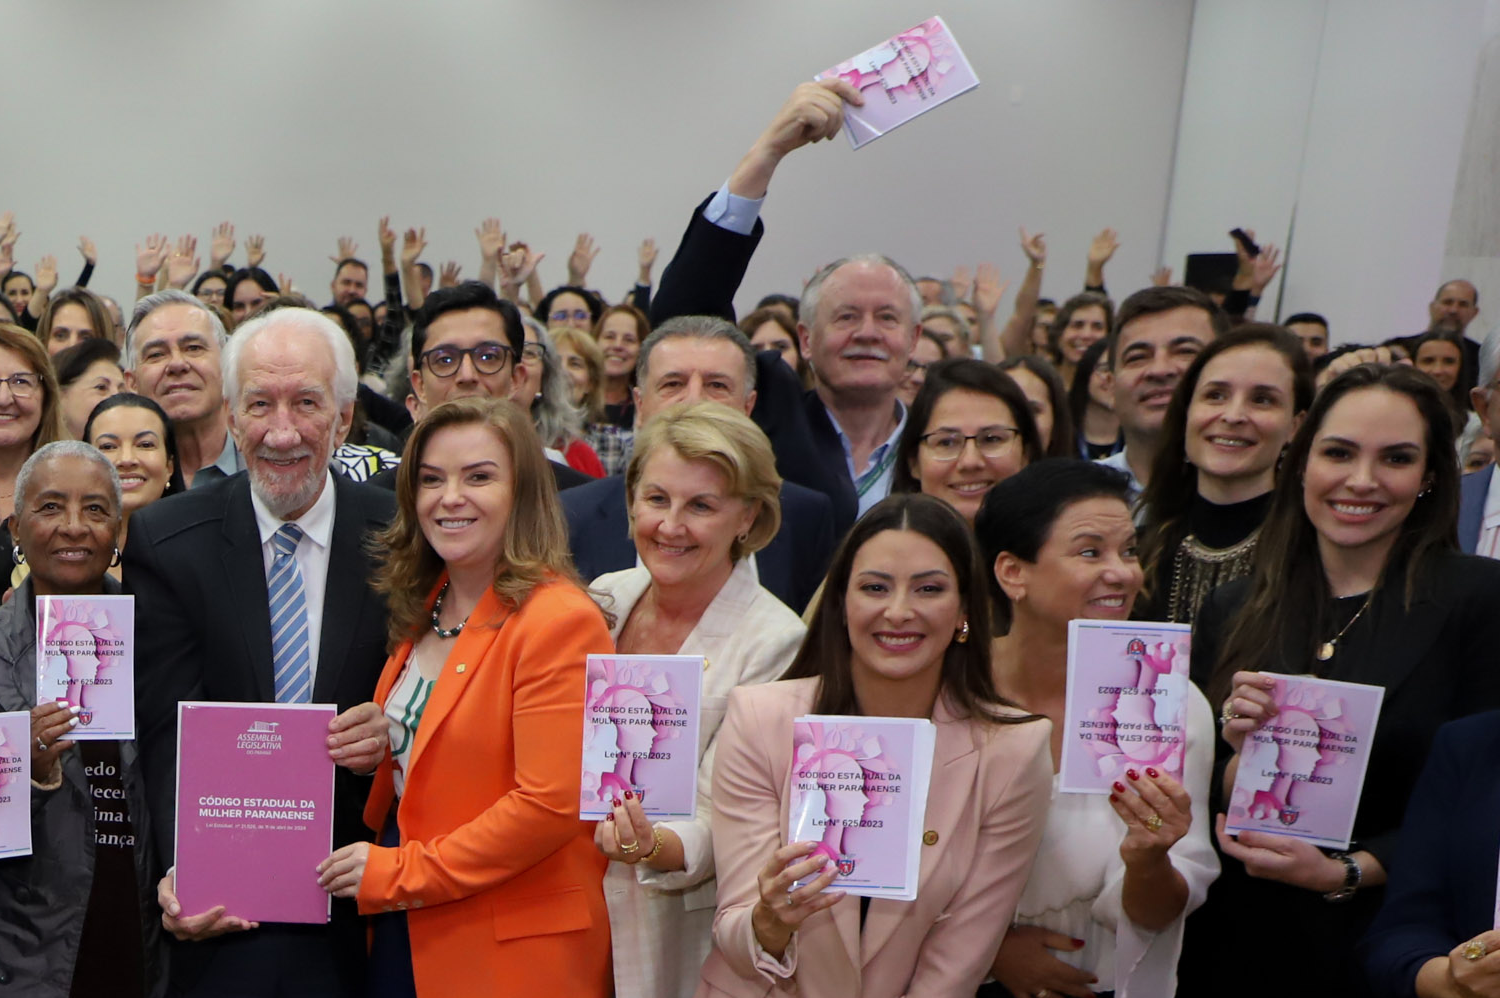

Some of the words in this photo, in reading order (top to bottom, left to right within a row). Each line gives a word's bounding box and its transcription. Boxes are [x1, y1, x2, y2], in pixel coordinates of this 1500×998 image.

[592, 705, 626, 713] CÓDIGO
[628, 707, 673, 715] ESTADUAL
[592, 717, 627, 725] MULHER
[629, 719, 688, 727] PARANAENSE
[1080, 720, 1142, 730] PARANAENSE
[237, 733, 282, 742] ASSEMBLEIA
[1079, 732, 1092, 740] DA
[1095, 733, 1141, 742] ESTADUAL
[1293, 729, 1341, 742] ESTADUAL
[1344, 735, 1358, 743] DA
[237, 741, 282, 750] LEGISLATIVA
[1292, 740, 1357, 754] PARANAENSE
[837, 772, 886, 780] ESTADUAL
[888, 773, 901, 781] DA
[798, 783, 836, 791] MULHER
[838, 784, 901, 793] PARANAENSE
[199, 795, 241, 807] CÓDIGO
[243, 798, 297, 808] ESTADUAL
[300, 799, 315, 809] DA
[199, 808, 242, 818] MULHER
[245, 809, 315, 820] PARANAENSE
